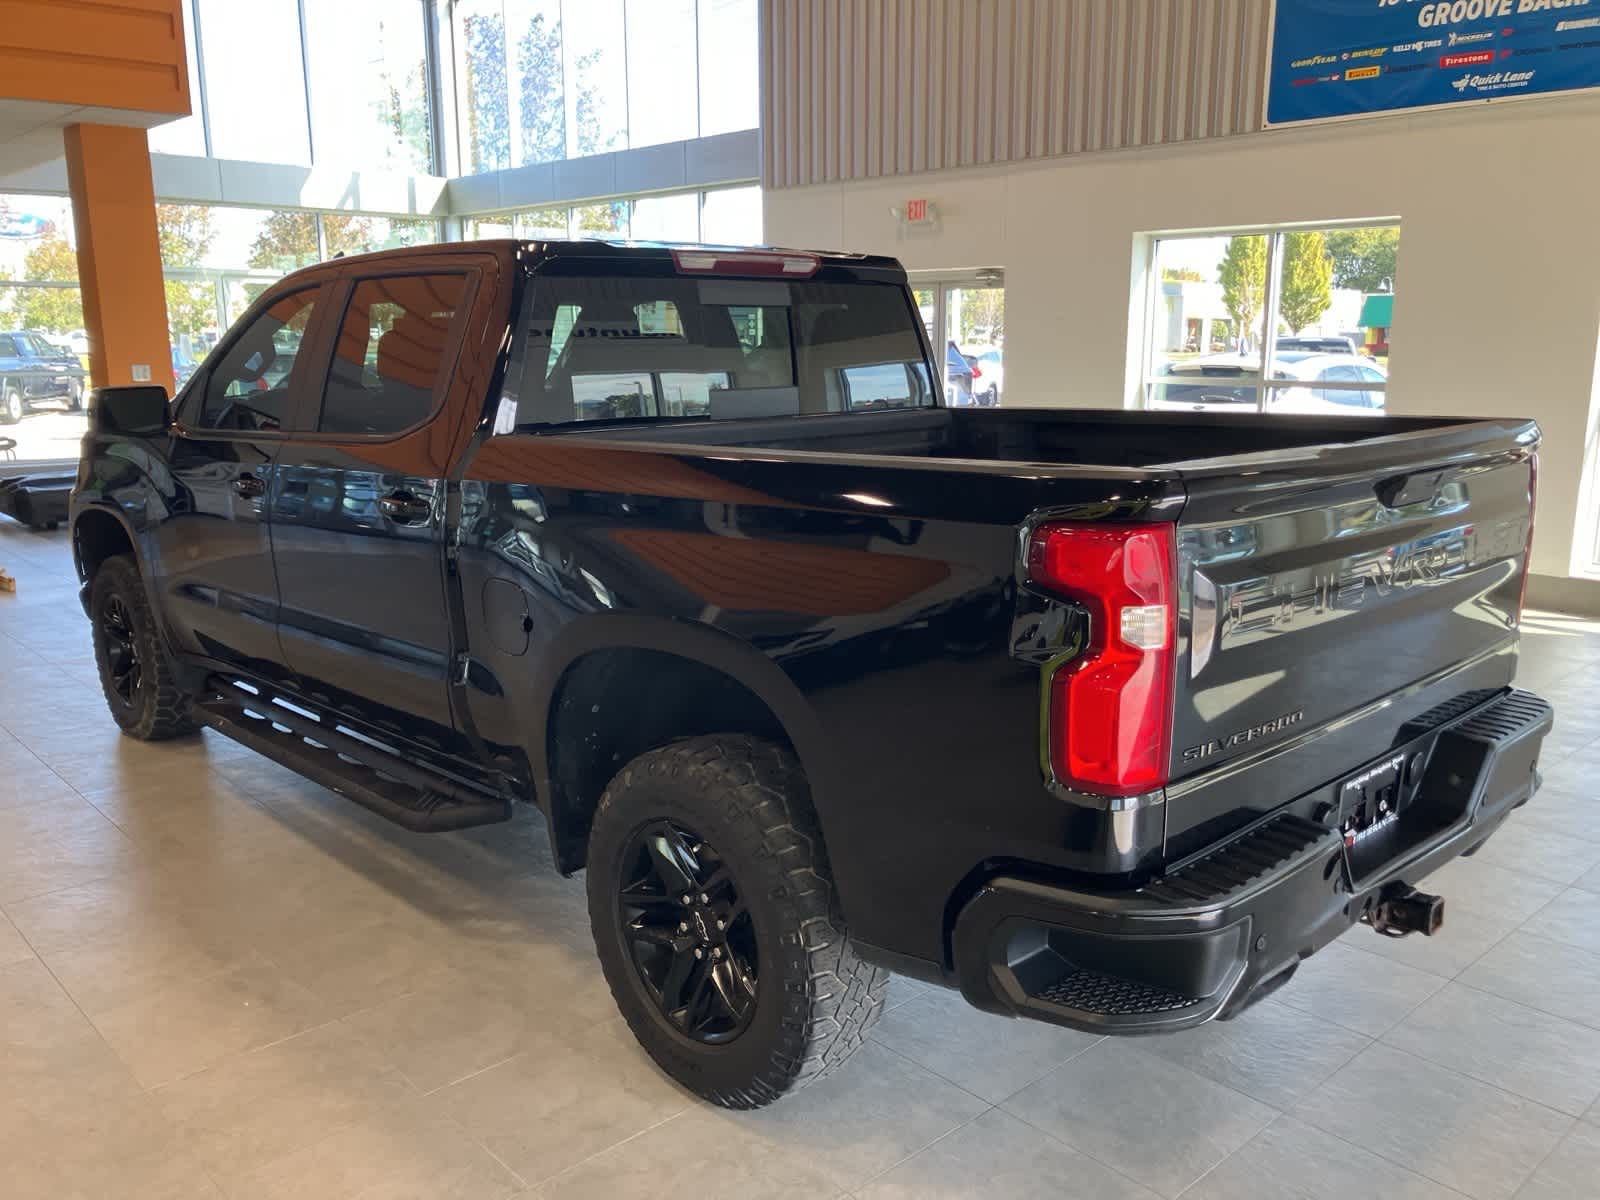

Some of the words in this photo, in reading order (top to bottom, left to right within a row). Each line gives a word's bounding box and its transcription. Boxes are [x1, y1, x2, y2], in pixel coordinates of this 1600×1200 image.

[1418, 0, 1513, 28] GROOVE
[1290, 55, 1337, 68] GOODYEAR
[1445, 54, 1489, 66] Firestone
[1469, 72, 1503, 87] Quick
[1503, 71, 1534, 82] Lane
[1182, 710, 1304, 764] SILVERADO
